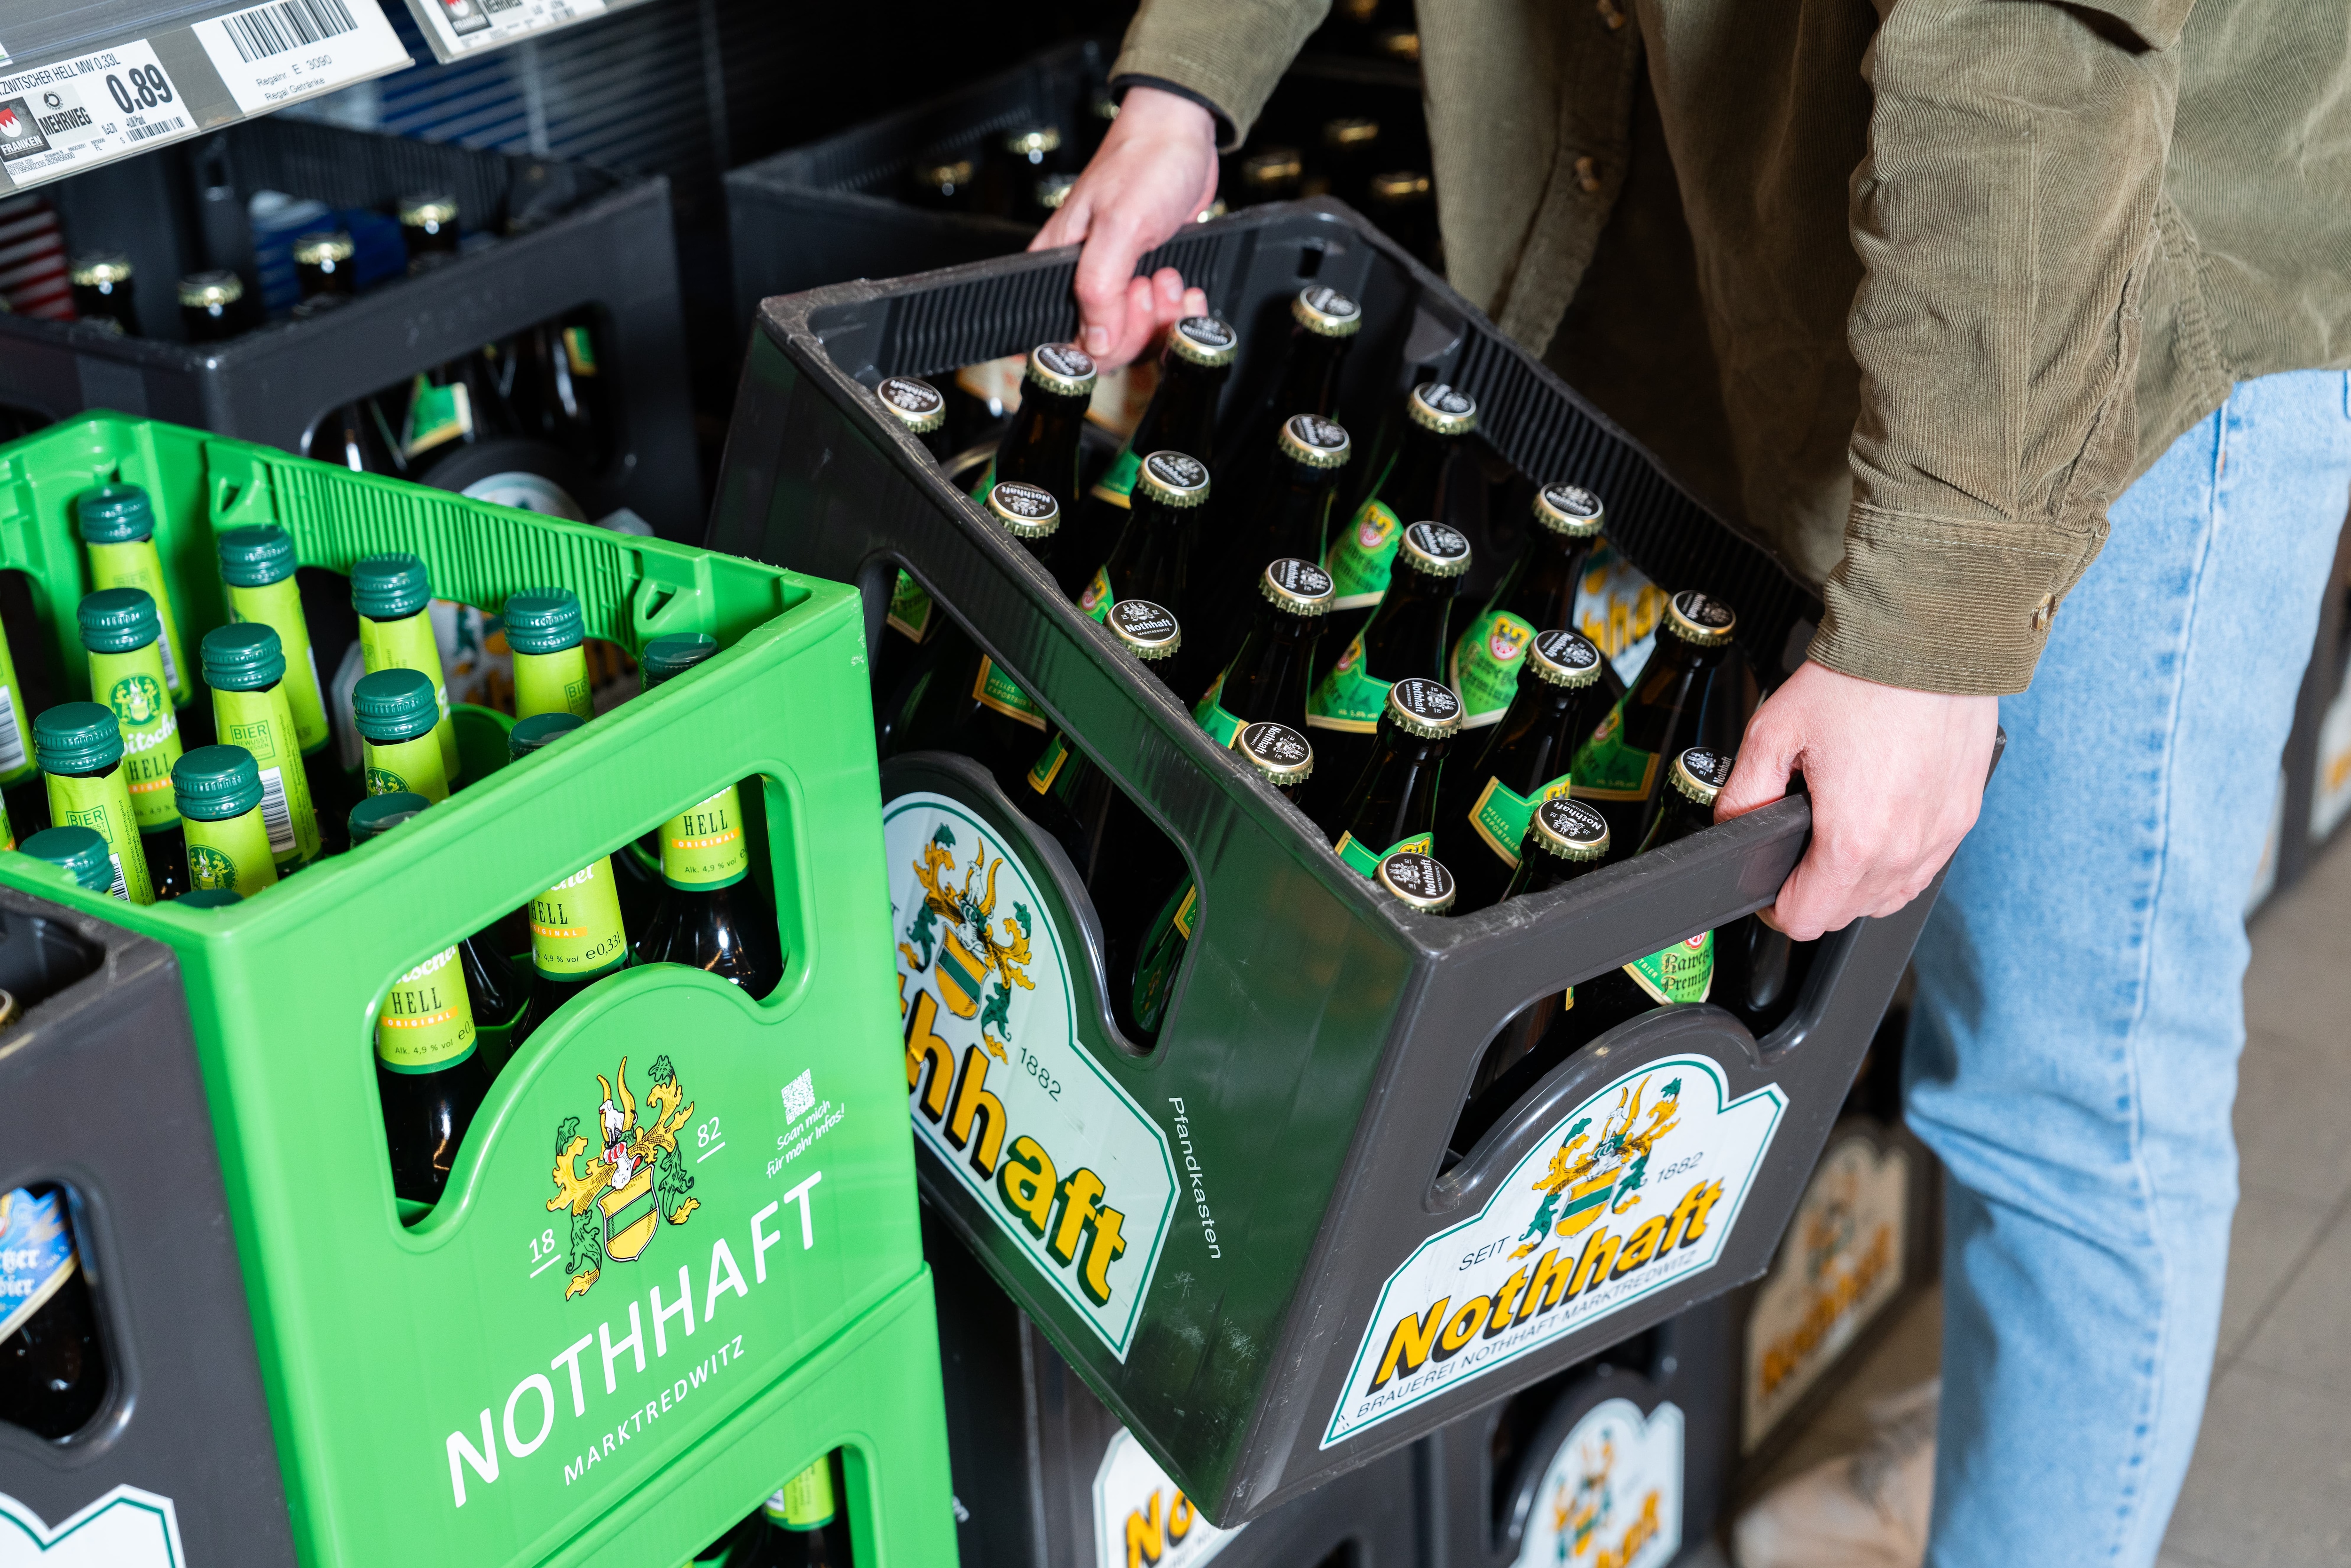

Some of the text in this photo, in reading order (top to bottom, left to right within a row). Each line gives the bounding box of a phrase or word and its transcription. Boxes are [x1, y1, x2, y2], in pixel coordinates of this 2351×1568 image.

[52, 64, 78, 81] HELL
[75, 58, 95, 74] MW
[94, 53, 121, 71] 0,33L
[292, 63, 302, 75] E
[306, 54, 332, 70] 3090
[106, 64, 173, 114] 0.89
[264, 78, 325, 101] Regal Getränke
[38, 106, 93, 136] MEHRWEG
[0, 135, 44, 155] FRANKEN
[1001, 486, 1051, 504] Nothhaft
[1285, 559, 1301, 590] Nothhaft
[1125, 619, 1173, 633] Nothhaft
[1137, 628, 1170, 636] MARKTREDWITZ
[1412, 681, 1427, 713] Nothhaft
[233, 724, 268, 740] BIER
[236, 736, 268, 746] BEWUSST
[1250, 725, 1267, 746] MARKTREDWITZ
[1254, 725, 1282, 755] Nothhaft
[127, 754, 172, 781] HELL
[1712, 756, 1733, 785] Nothhaft
[69, 809, 104, 827] BIER
[118, 799, 132, 845] Reinheitsgebot
[683, 809, 728, 836] HELL
[1486, 806, 1510, 831] HELLES
[1554, 801, 1602, 830] Nothhaft
[1565, 801, 1599, 821] MARKTREDWITZ
[678, 832, 735, 848] ORIGINAL
[130, 846, 141, 883] bayerischen
[702, 864, 715, 873] 4,9
[727, 857, 737, 867] vol
[1420, 859, 1437, 896] Nothhaft
[1435, 865, 1444, 892] MARKTREDWITZ
[531, 898, 568, 925] HELL
[544, 953, 554, 963] 4,9
[391, 987, 442, 1014] HELL
[388, 1012, 450, 1027] ORIGINAL
[413, 1046, 427, 1055] 4,9
[441, 1039, 453, 1048] vol
[1020, 1046, 1062, 1102] 1882
[696, 1116, 723, 1149] 82
[777, 1100, 831, 1150] Scan mich
[765, 1102, 845, 1179] für mehr Infos!
[1168, 1096, 1222, 1260] Pfandkasten
[1656, 1150, 1705, 1184] 1882
[528, 1228, 557, 1265] 18
[1459, 1236, 1511, 1272] SEIT
[1365, 1175, 1726, 1398] Nothhaft
[445, 1170, 823, 1509] NOTHHAFT
[1356, 1363, 1456, 1418] BRAUEREI
[564, 1334, 746, 1486] MARKTREDWITZ
